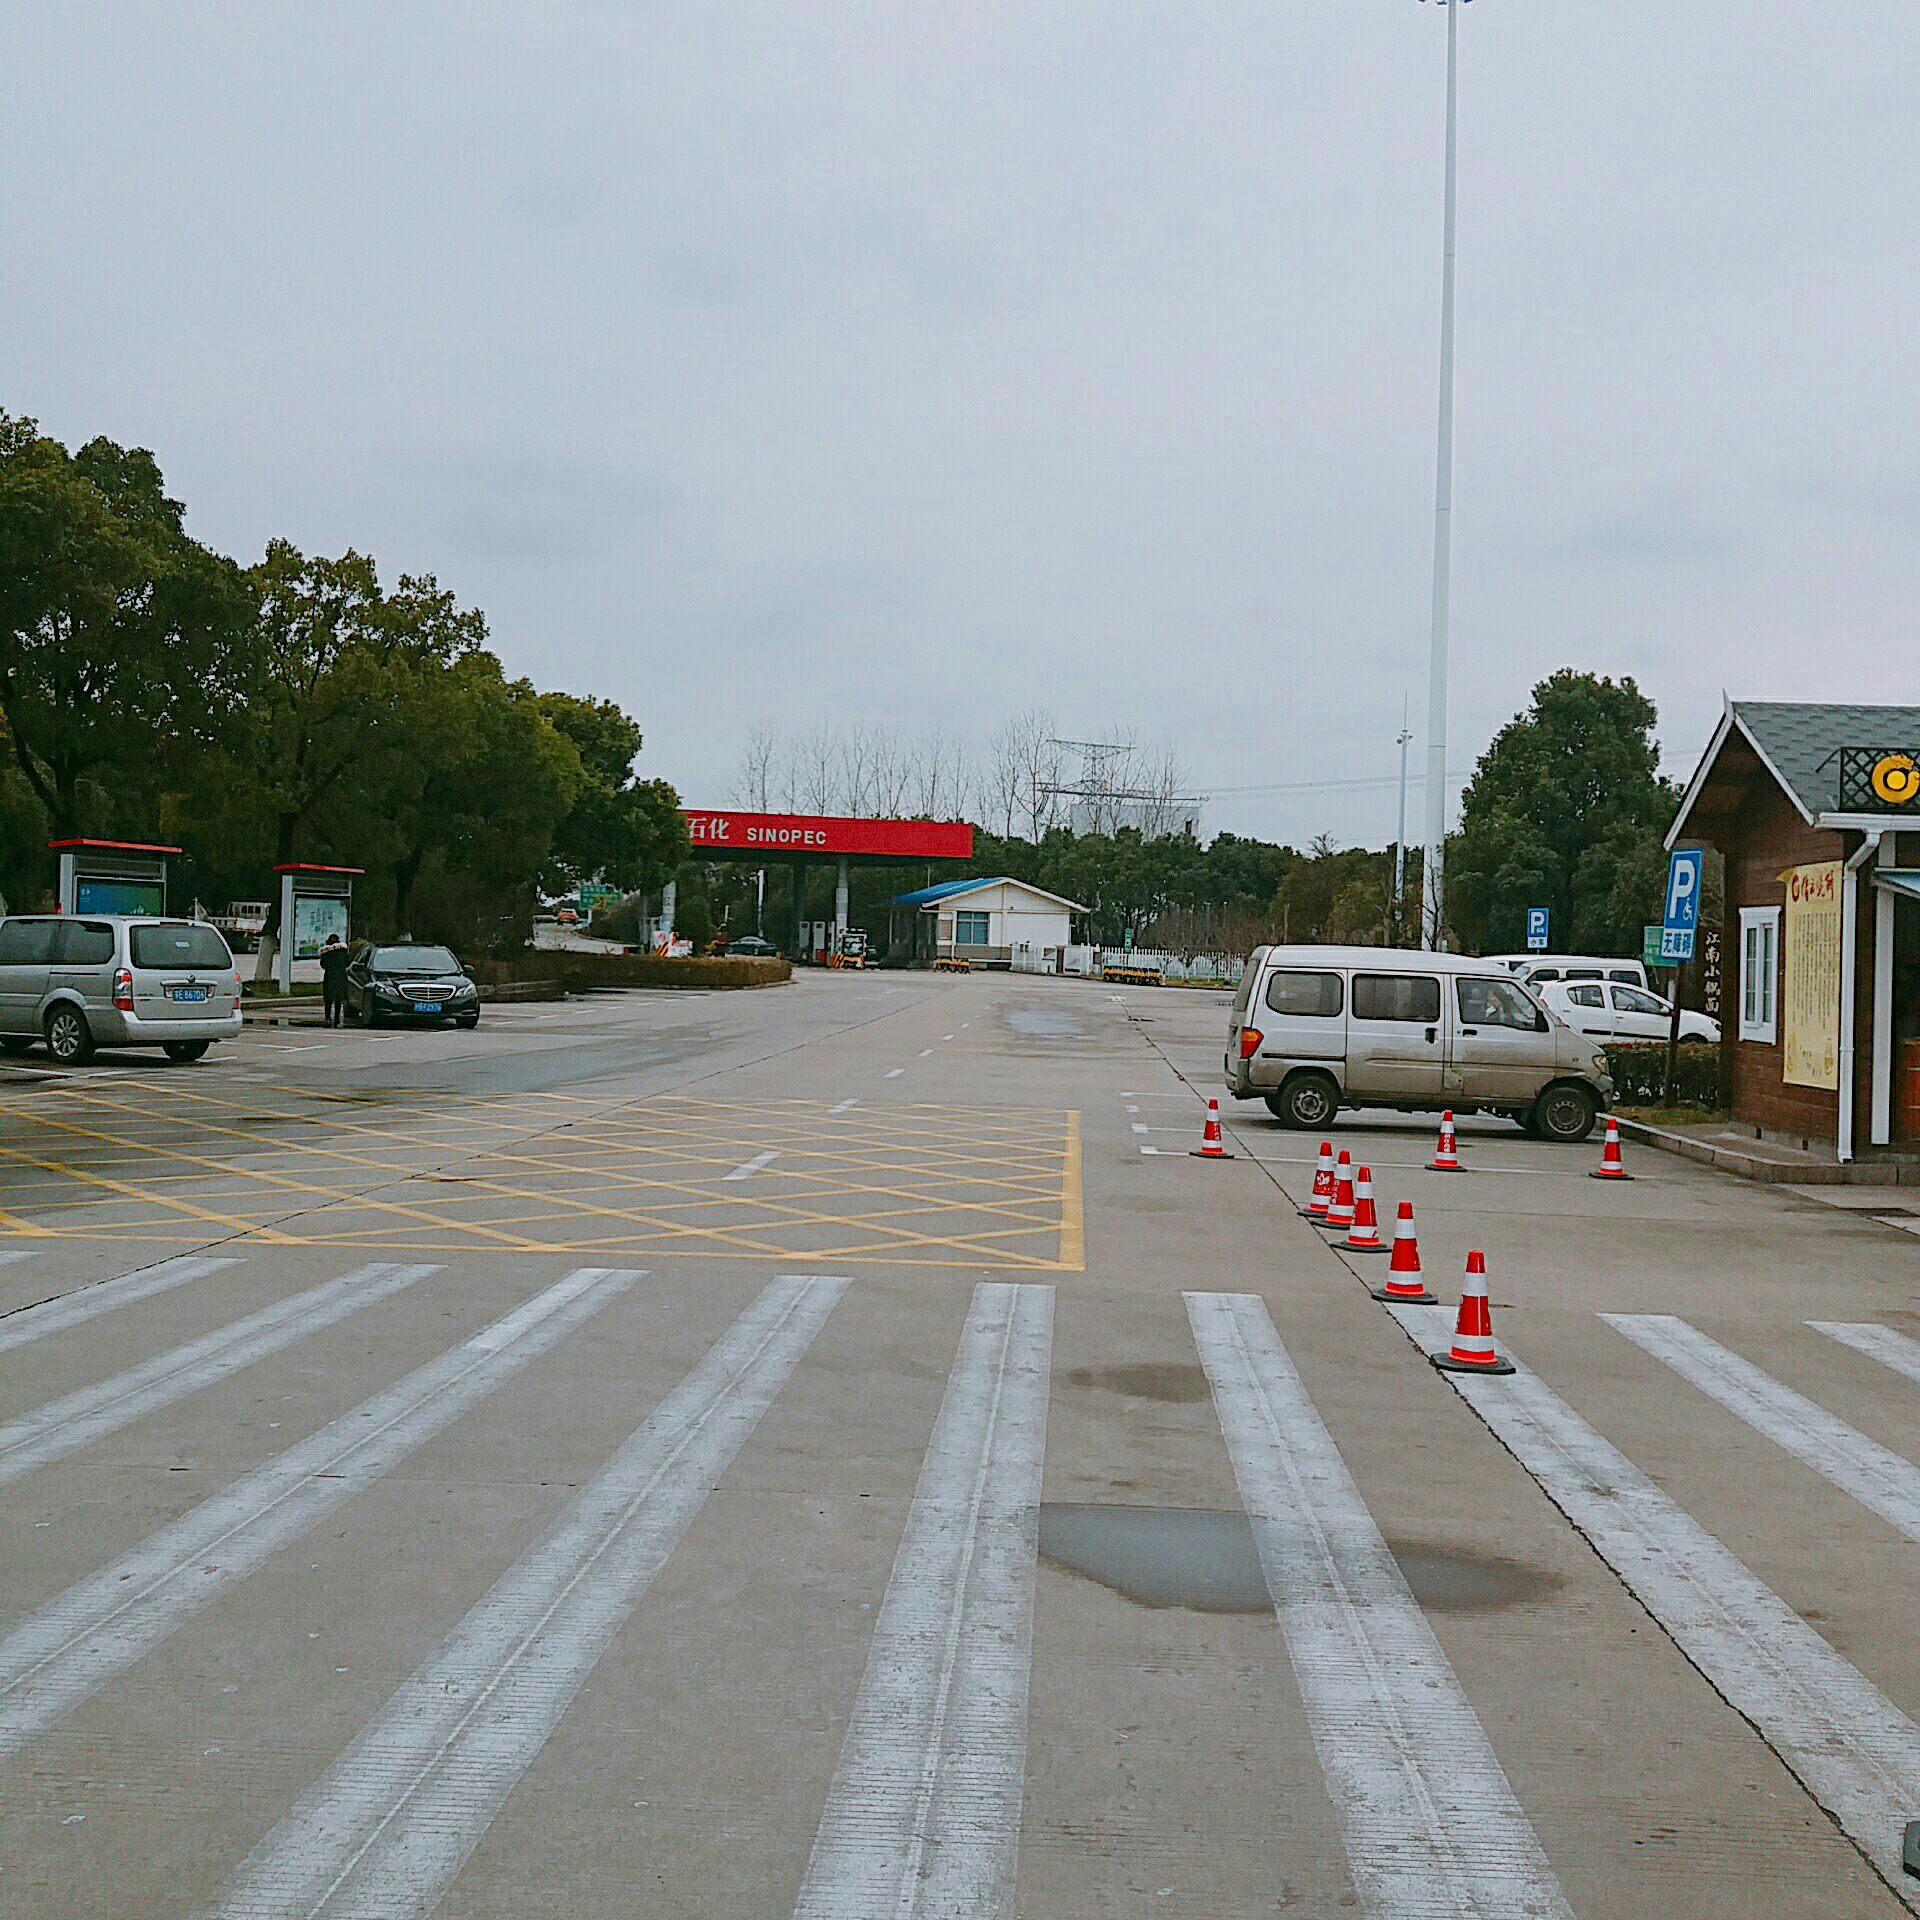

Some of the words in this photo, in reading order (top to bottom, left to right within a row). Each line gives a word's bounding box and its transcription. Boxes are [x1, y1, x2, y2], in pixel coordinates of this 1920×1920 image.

[687, 817, 730, 840] 石化
[746, 827, 827, 845] SINOPEC
[1669, 859, 1695, 919] P
[1530, 911, 1545, 934] P
[1663, 931, 1692, 955] 无障碍
